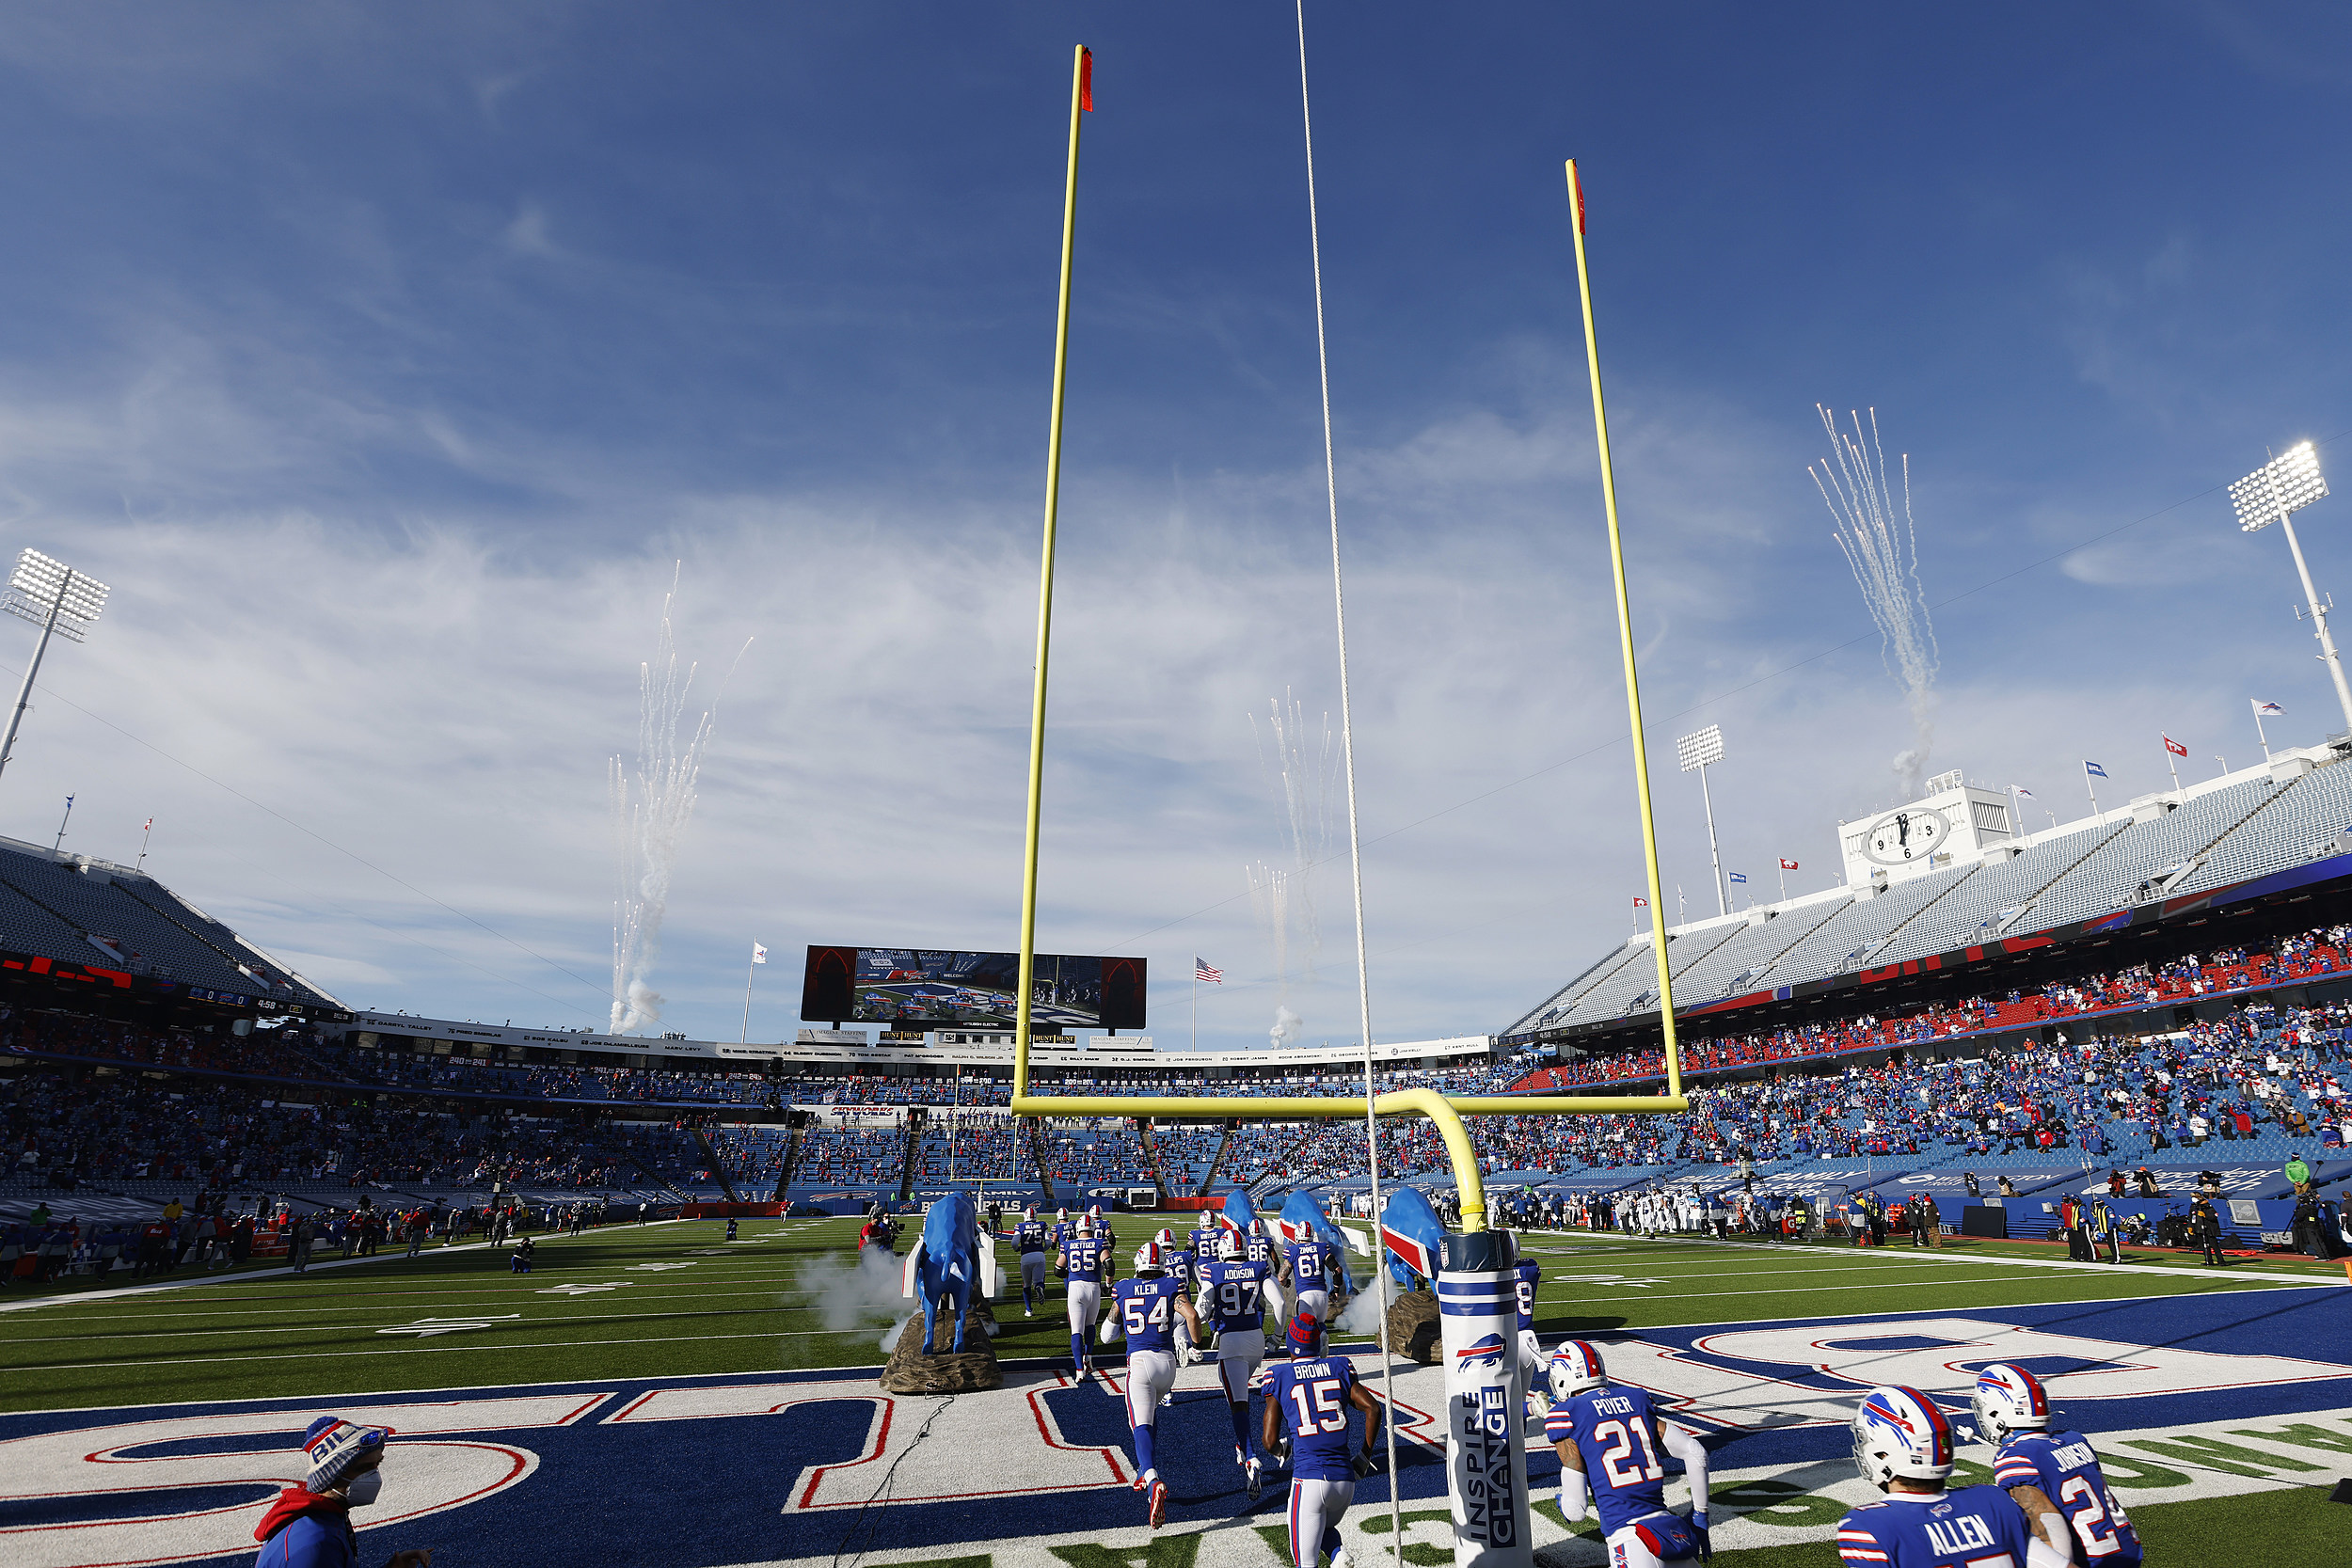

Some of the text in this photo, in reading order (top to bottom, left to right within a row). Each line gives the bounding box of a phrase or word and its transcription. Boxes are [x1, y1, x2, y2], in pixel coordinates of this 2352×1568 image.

[1925, 825, 1932, 836] 3
[1877, 840, 1884, 850] 9
[1903, 848, 1911, 860] 6
[207, 990, 215, 1000] 0
[237, 995, 245, 1005] 0
[257, 999, 277, 1010] 4:58
[449, 1056, 465, 1065] 240
[831, 1106, 895, 1117] SKYWORKS
[1762, 1170, 1868, 1181] FAMILY
[1024, 1229, 1042, 1245] 75
[1069, 1242, 1095, 1250] BOETTGER
[1248, 1244, 1269, 1262] 86
[1298, 1245, 1319, 1254] ZIMMER
[1068, 1250, 1097, 1272] 65
[1297, 1253, 1322, 1278] 61
[1224, 1267, 1255, 1280] ADDISON
[1134, 1282, 1159, 1296] KLEIN
[1219, 1280, 1262, 1317] 97
[1123, 1296, 1170, 1335] 54
[1289, 1323, 1317, 1343] BILLS
[1293, 1362, 1332, 1381] BROWN
[1290, 1378, 1347, 1438] 15
[1591, 1396, 1635, 1418] POYER
[1593, 1415, 1664, 1490] 21
[2049, 1441, 2098, 1474] JOHNSON
[1461, 1391, 1489, 1542] INSPIRE
[1484, 1391, 1514, 1544] CHANGE
[1923, 1513, 1996, 1558] ALLEN
